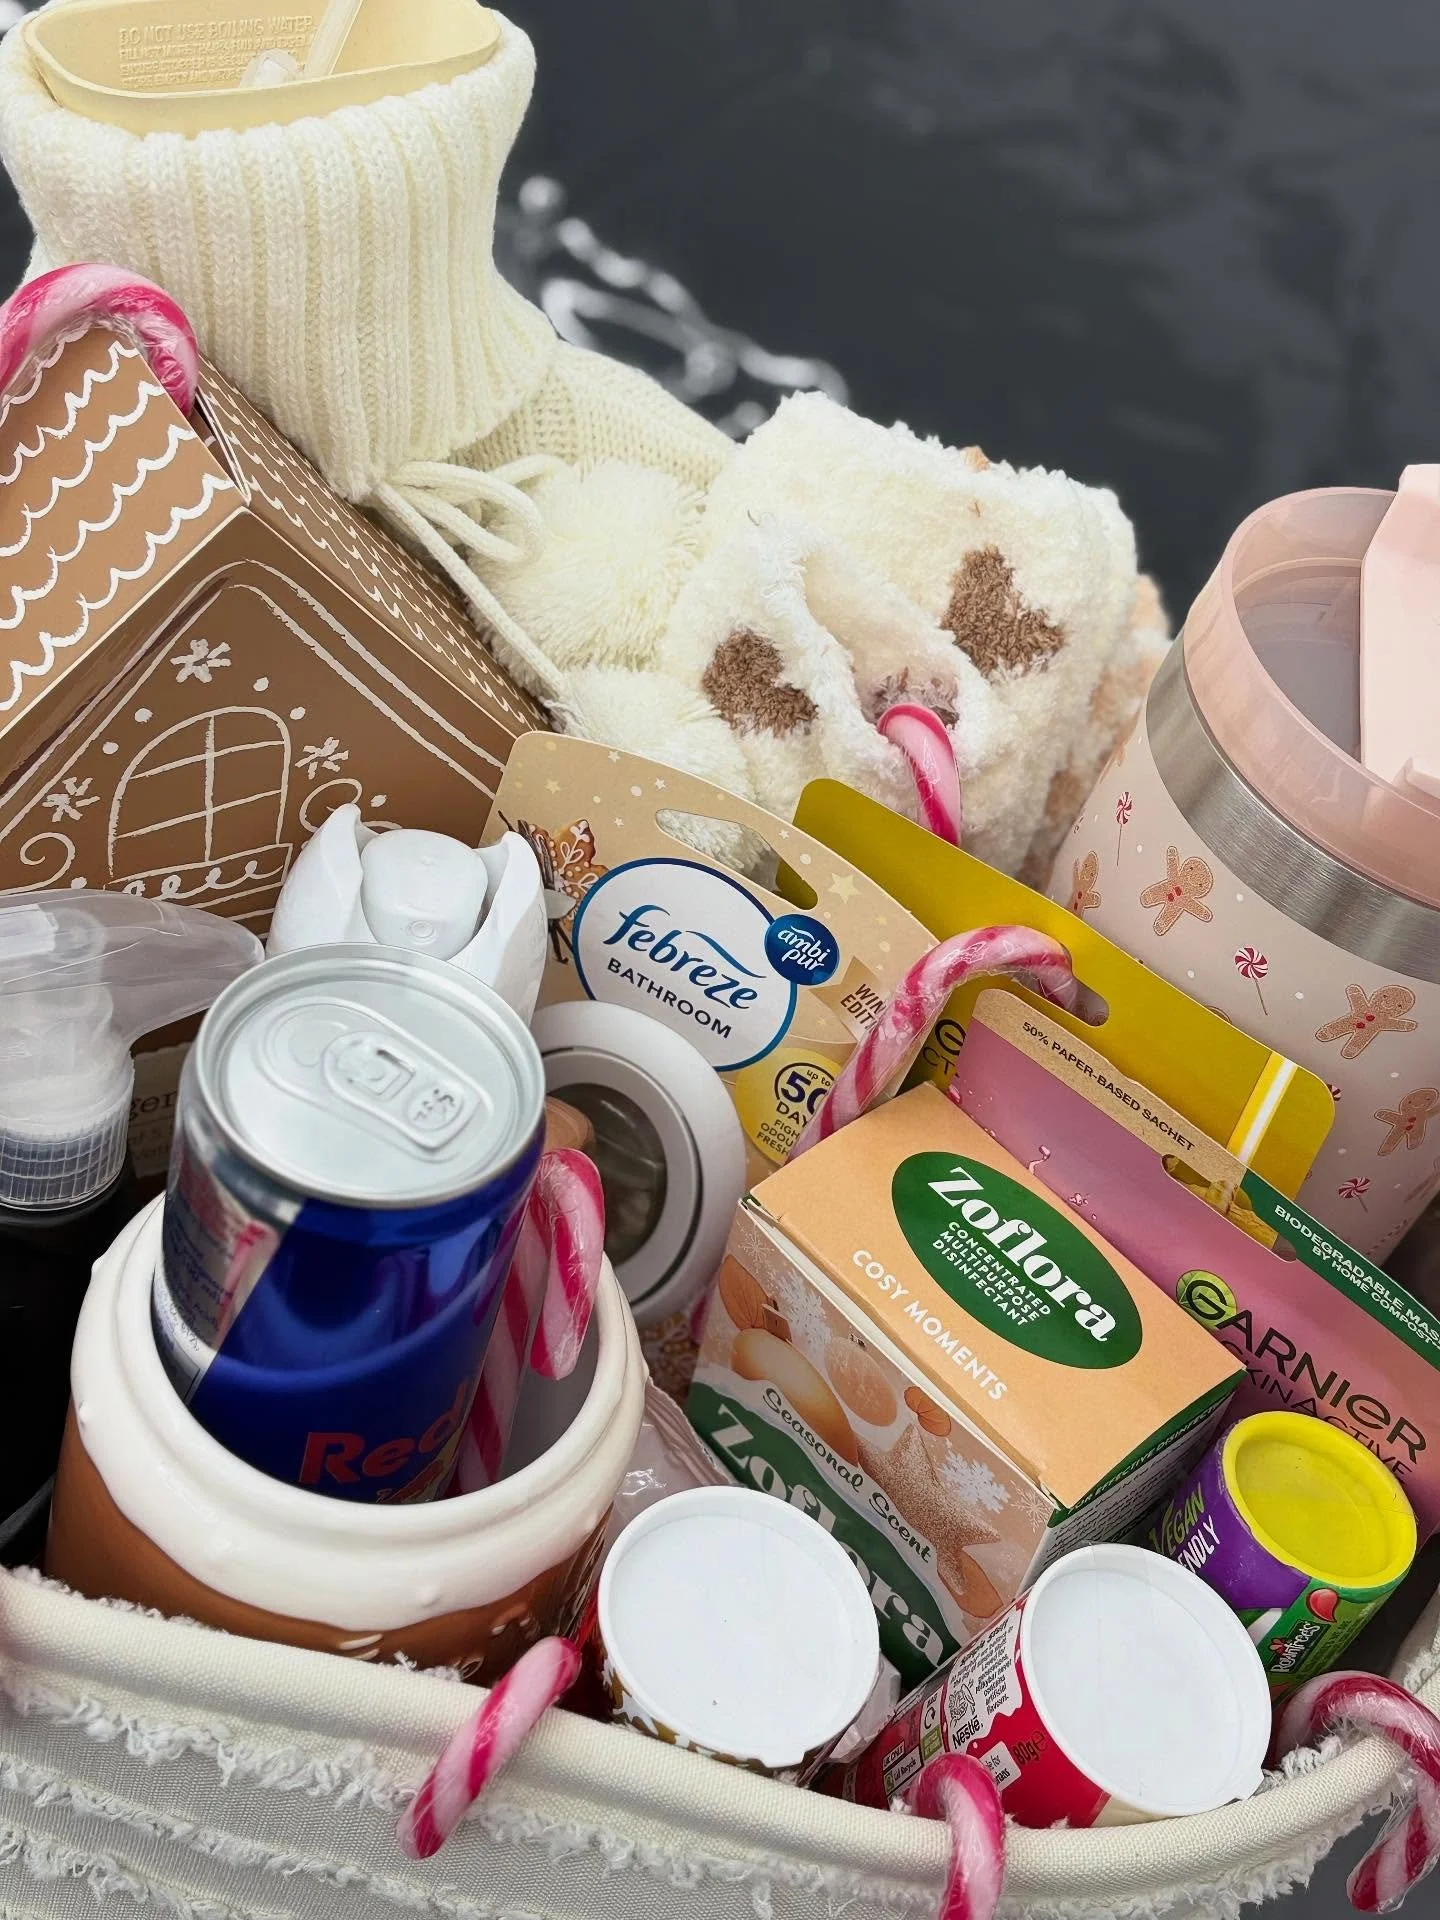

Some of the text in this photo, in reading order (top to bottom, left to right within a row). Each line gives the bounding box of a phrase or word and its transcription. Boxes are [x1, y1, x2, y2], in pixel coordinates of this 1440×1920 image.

[119, 28, 141, 46] DO
[145, 25, 173, 43] NOT
[178, 23, 205, 41] USE
[209, 19, 264, 38] BOILING
[603, 905, 767, 1009] febreze
[777, 926, 830, 962] ambi
[781, 947, 824, 970] pur
[607, 958, 732, 1038] BATHROOM
[855, 984, 887, 1014] WIN
[776, 1102, 810, 1127] DAY
[806, 1070, 831, 1087] up to
[1023, 1022, 1196, 1151] 50% PAPER-BASED SACHET
[757, 1131, 789, 1155] FRESH
[761, 1122, 794, 1147] ODOU
[773, 1119, 800, 1139] FIGH
[928, 1167, 1116, 1342] Zoflora
[932, 1239, 1029, 1327] DISINFECTANT
[939, 1230, 1039, 1322] MULTIPURPOSE
[948, 1221, 1051, 1316] CONCENTRATED
[1275, 1204, 1404, 1311] BIODEGRADABLE
[852, 1249, 1008, 1400] COSY MOMENTS
[1312, 1246, 1440, 1350] BY HOME COMPOST
[1186, 1279, 1427, 1464] GARNIER
[298, 1374, 470, 1485] Red
[763, 1387, 932, 1564] Seasonal Scent
[1150, 1482, 1206, 1554] VEGAN
[1177, 1514, 1221, 1576] ENDLY
